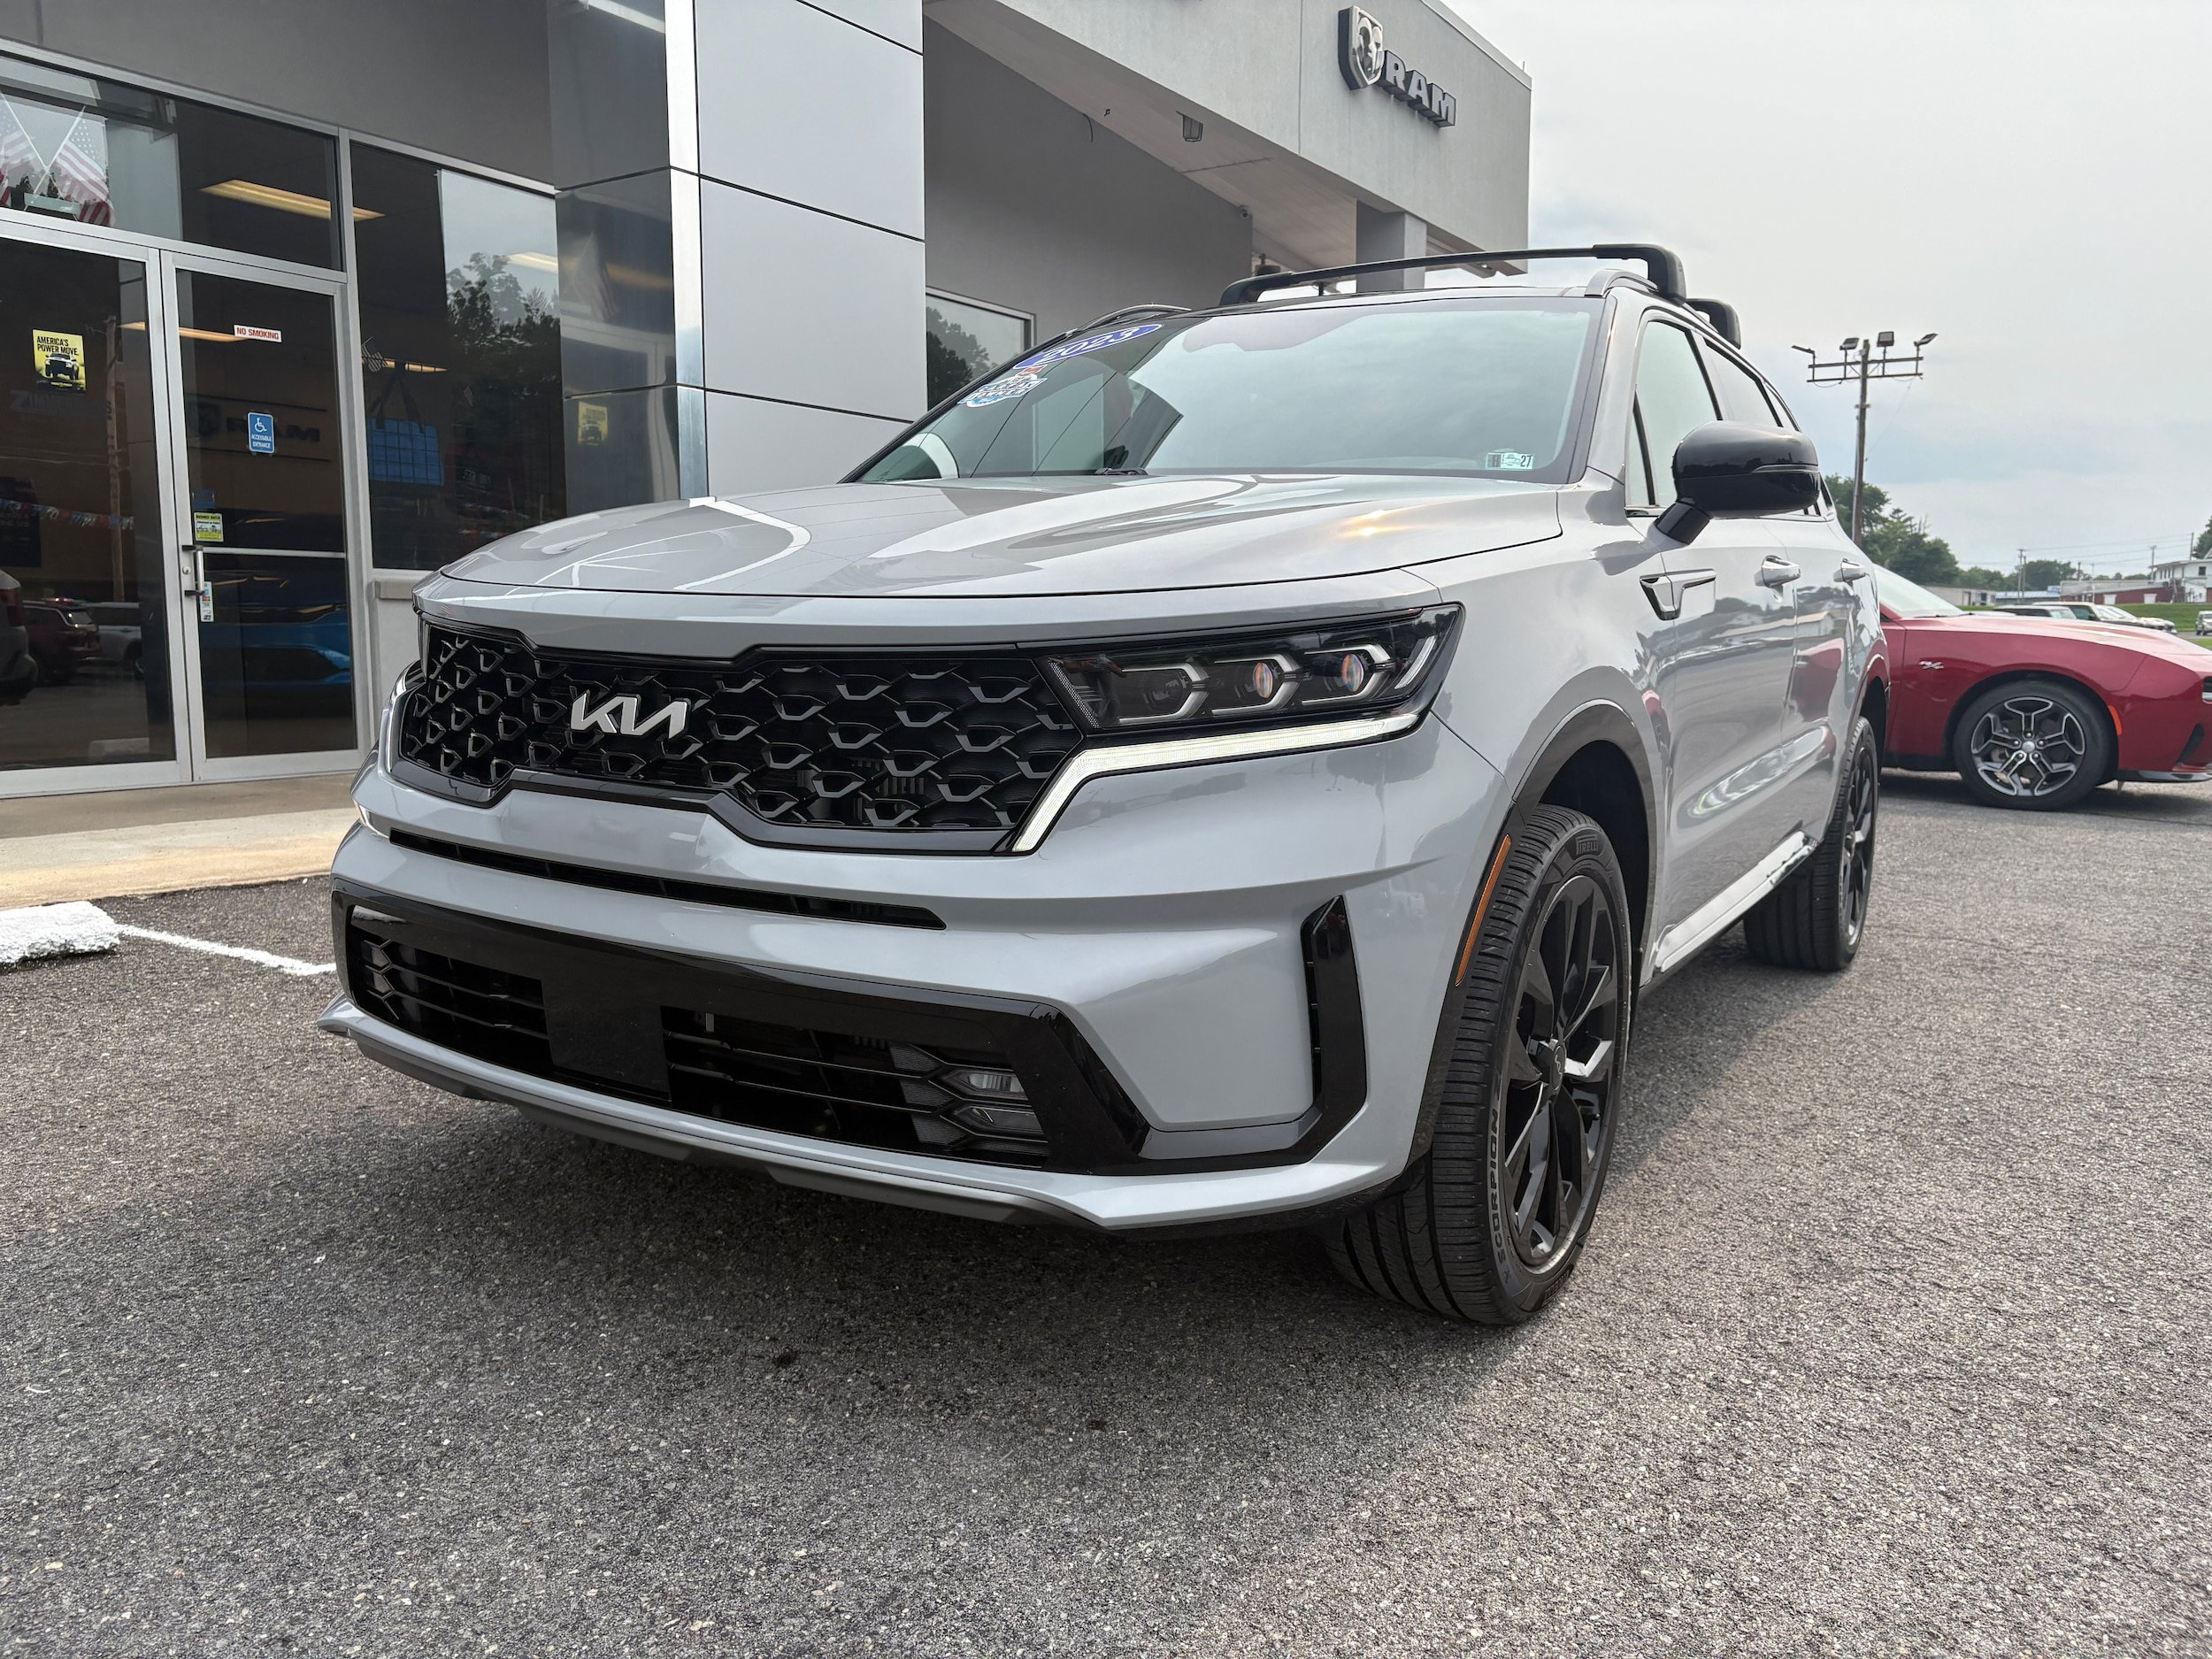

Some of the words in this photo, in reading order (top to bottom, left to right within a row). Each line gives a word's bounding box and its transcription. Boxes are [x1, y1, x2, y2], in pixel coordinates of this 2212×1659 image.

[1382, 50, 1456, 127] RAM
[36, 335, 69, 347] AMERICA'S
[236, 326, 247, 335] NO
[248, 328, 280, 340] SMOKING
[37, 343, 59, 353] POWER
[1032, 327, 1141, 366] 2023
[1520, 454, 1533, 468] 27
[570, 690, 689, 740] KIA
[1489, 1108, 1505, 1264] SCORPION
